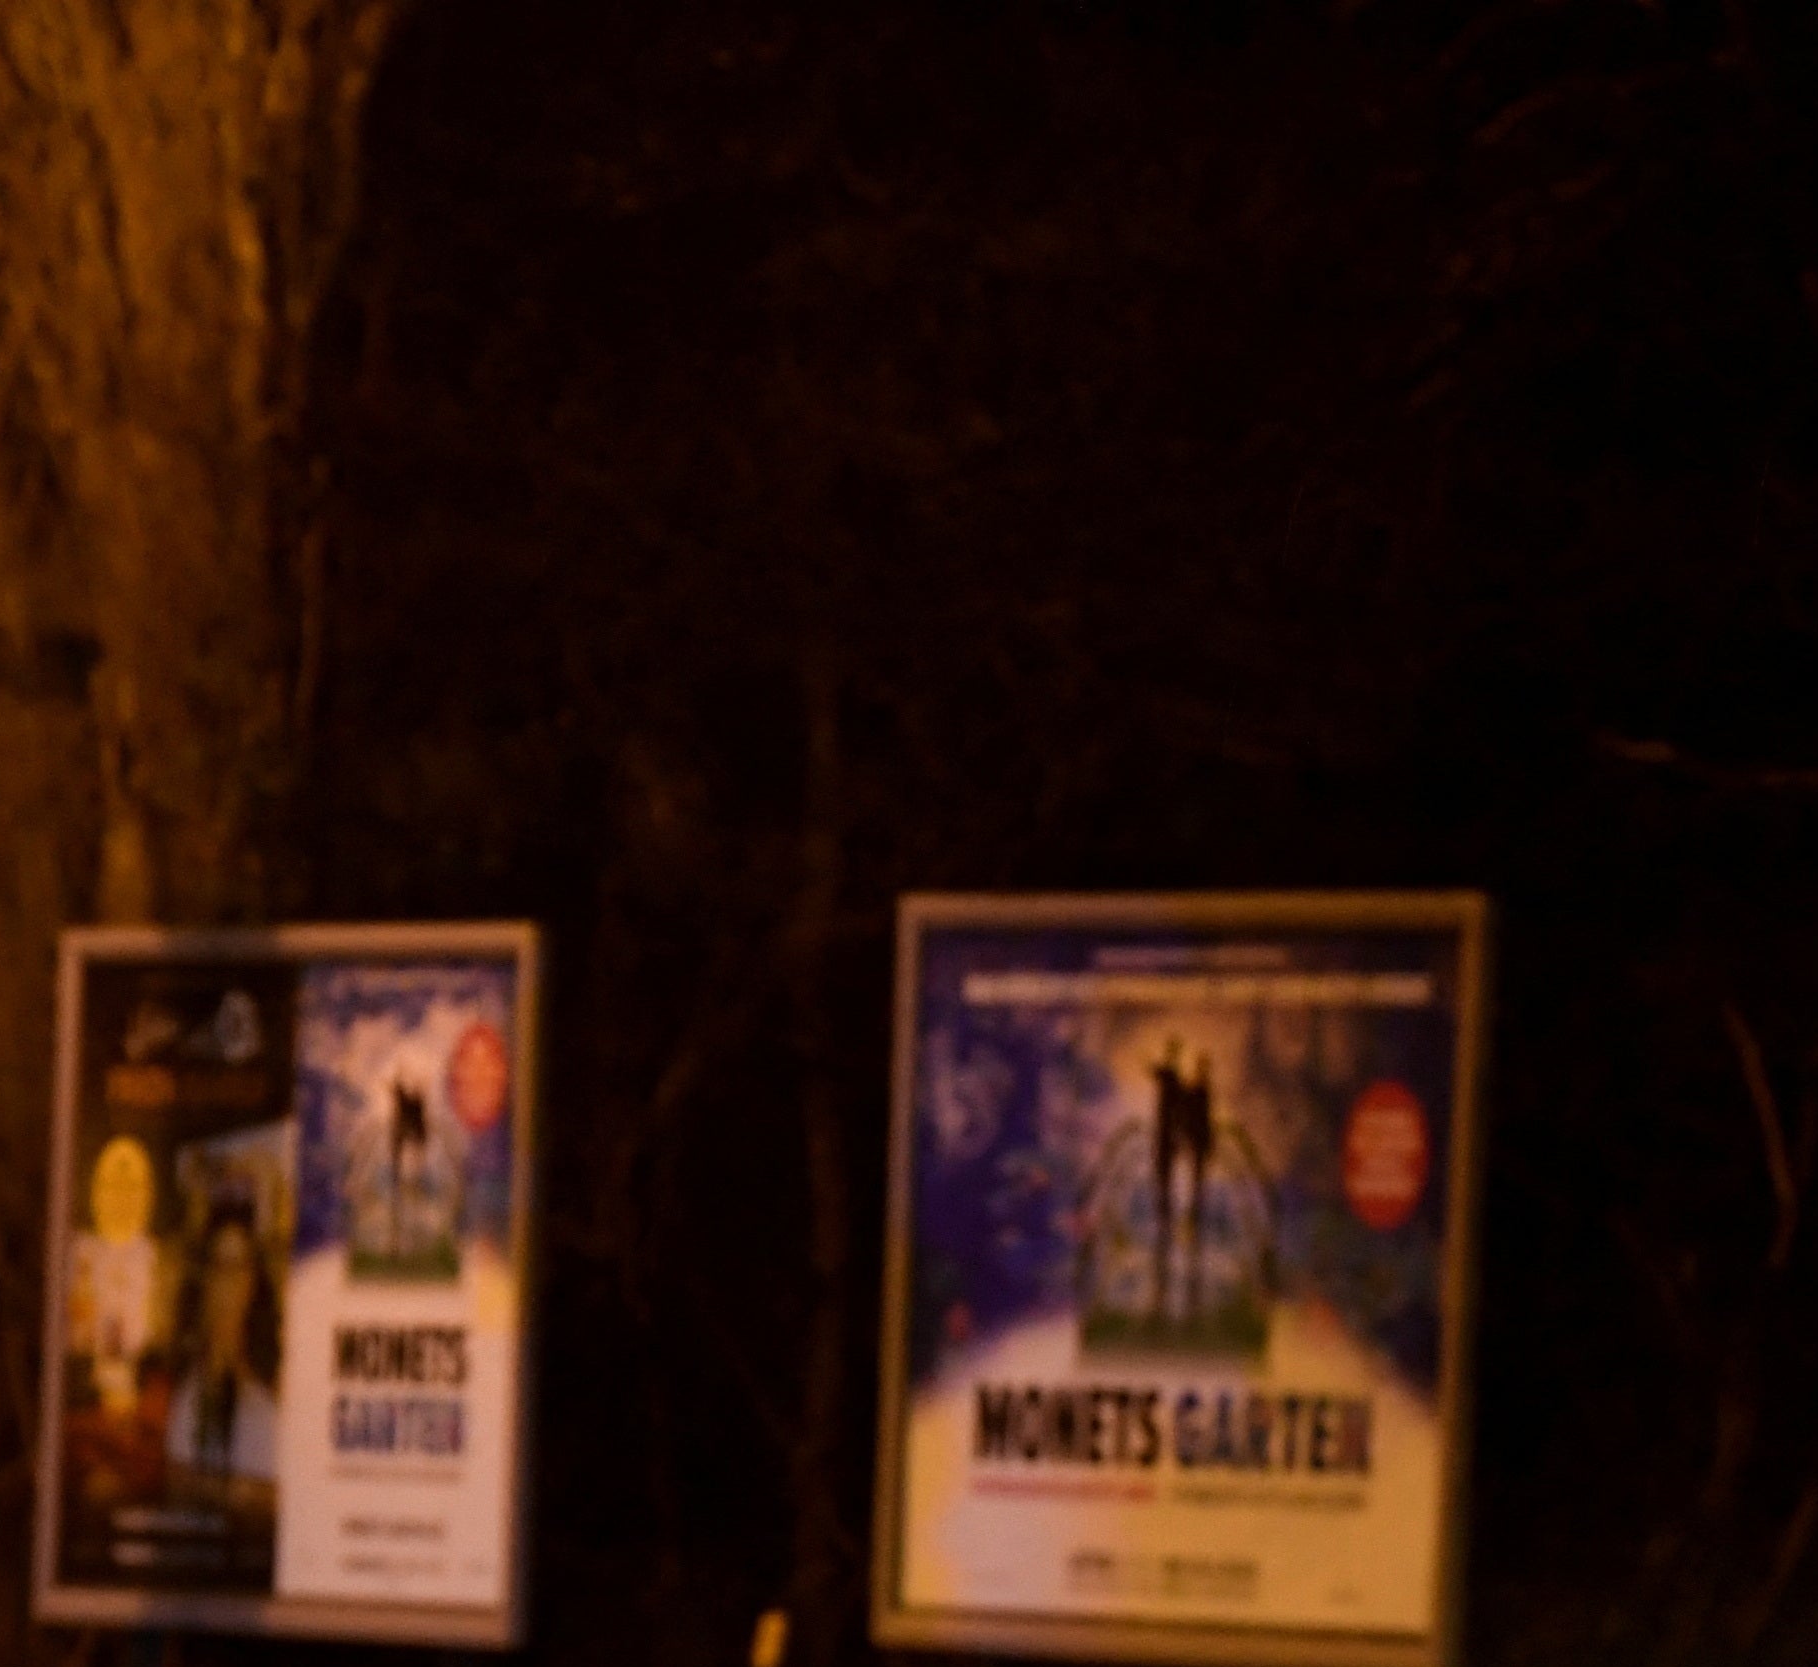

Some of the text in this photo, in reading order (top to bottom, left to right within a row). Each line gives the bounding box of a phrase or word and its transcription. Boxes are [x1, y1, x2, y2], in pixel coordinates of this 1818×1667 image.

[336, 1326, 468, 1386] MONETS
[976, 1386, 1370, 1474] MONETS GARTEN
